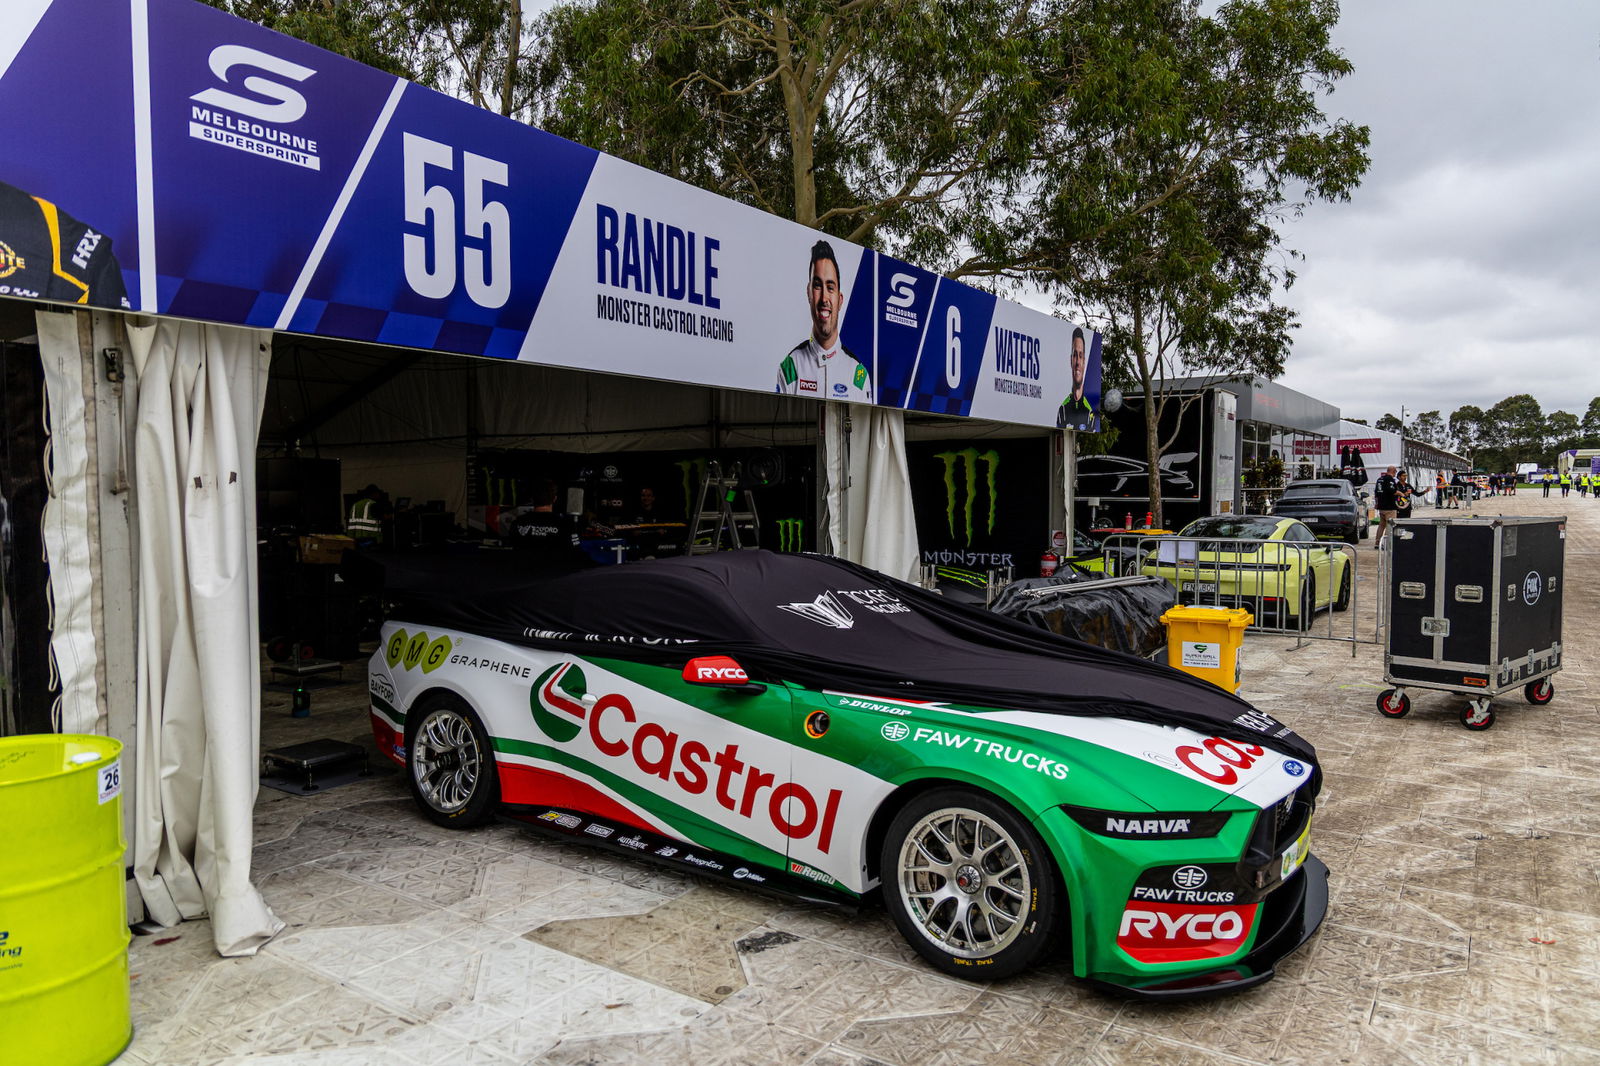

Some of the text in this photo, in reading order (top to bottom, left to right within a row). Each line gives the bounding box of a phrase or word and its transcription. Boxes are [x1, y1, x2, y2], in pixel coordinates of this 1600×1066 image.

[192, 105, 318, 153] MELBOURNE
[203, 128, 309, 165] SUPERSPRINT
[403, 131, 511, 309] 55
[72, 228, 102, 270] HRX
[597, 203, 721, 310] RANDLE
[597, 294, 734, 343] MONSTER CASTROL RACING
[886, 305, 917, 320] MELBOURNE
[946, 305, 962, 389] 6
[995, 326, 1041, 381] WATERS
[924, 549, 1014, 567] MONSTER
[391, 637, 444, 665] GMG
[450, 654, 531, 679] GRAPHENE
[697, 667, 748, 680] RYCO
[370, 679, 394, 703] BAYFORD
[849, 700, 912, 717] DUNLOP
[913, 728, 1070, 781] FAW TRUCKS
[105, 768, 119, 791] 26
[589, 694, 843, 855] Castrol
[1106, 817, 1189, 834] NARVA
[802, 865, 836, 885] Repco
[1133, 886, 1235, 903] FAW TRUCKS
[1118, 909, 1243, 940] RYCO
